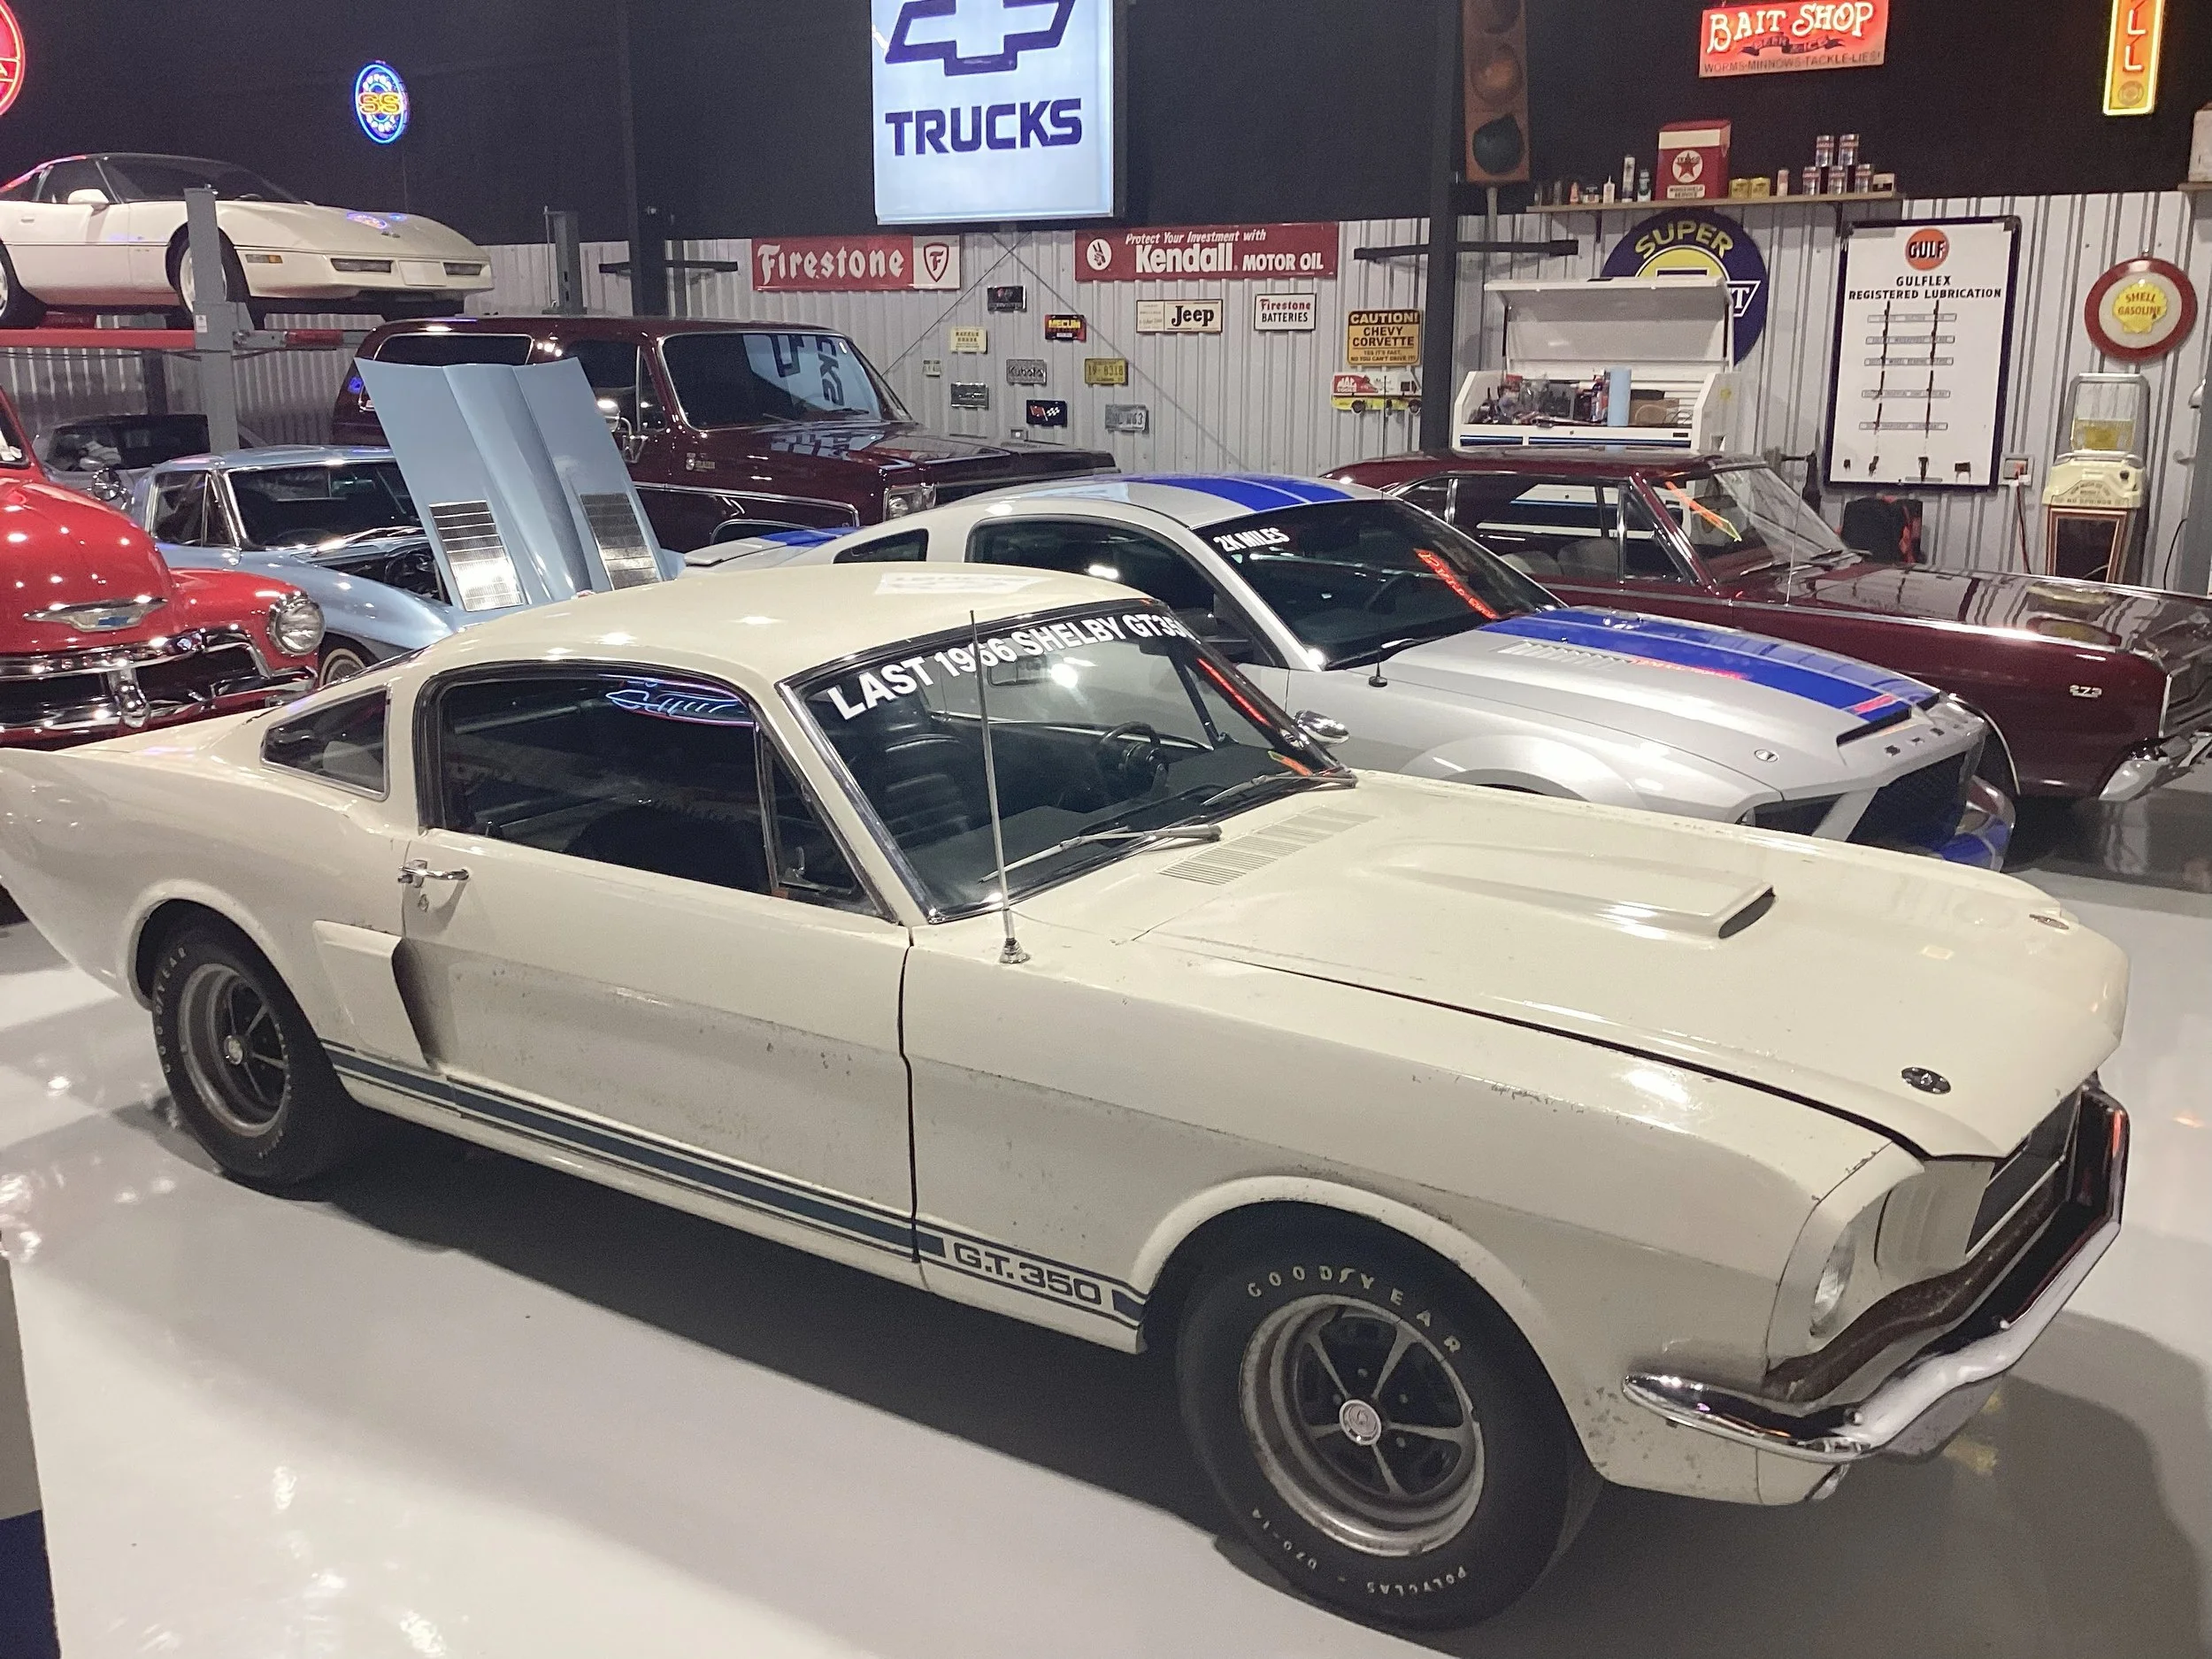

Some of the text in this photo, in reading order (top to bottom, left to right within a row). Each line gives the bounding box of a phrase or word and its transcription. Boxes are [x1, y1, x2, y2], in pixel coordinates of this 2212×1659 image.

[1706, 1, 1874, 54] BAIT SHOP
[357, 91, 402, 115] SS
[885, 97, 1082, 156] TRUCKS
[1125, 228, 1266, 245] Protect Your Investment with
[1635, 220, 1733, 259] SUPER
[1135, 243, 1325, 273] Kendall MOTOR OIL
[1909, 240, 1947, 259] GULF
[757, 244, 904, 285] Firestone
[1896, 275, 1952, 287] GULFLEX
[1848, 288, 2001, 300] REGISTERED LUBRICATION
[2125, 291, 2156, 303] SHELL
[1259, 298, 1311, 311] Firestone
[2117, 306, 2162, 316] GASOLINE
[1171, 305, 1215, 327] Jeep
[1261, 312, 1308, 323] BATTERIES
[1363, 326, 1403, 336] CHEVY
[1352, 336, 1415, 346] CORVETTE
[1009, 366, 1044, 378] Kubota
[1213, 527, 1290, 552] 2K MILES
[826, 657, 934, 720] LAST
[934, 638, 1018, 679] 1966
[1010, 616, 1127, 656] SHELBY
[1248, 1265, 1462, 1354] GOODYEAR
